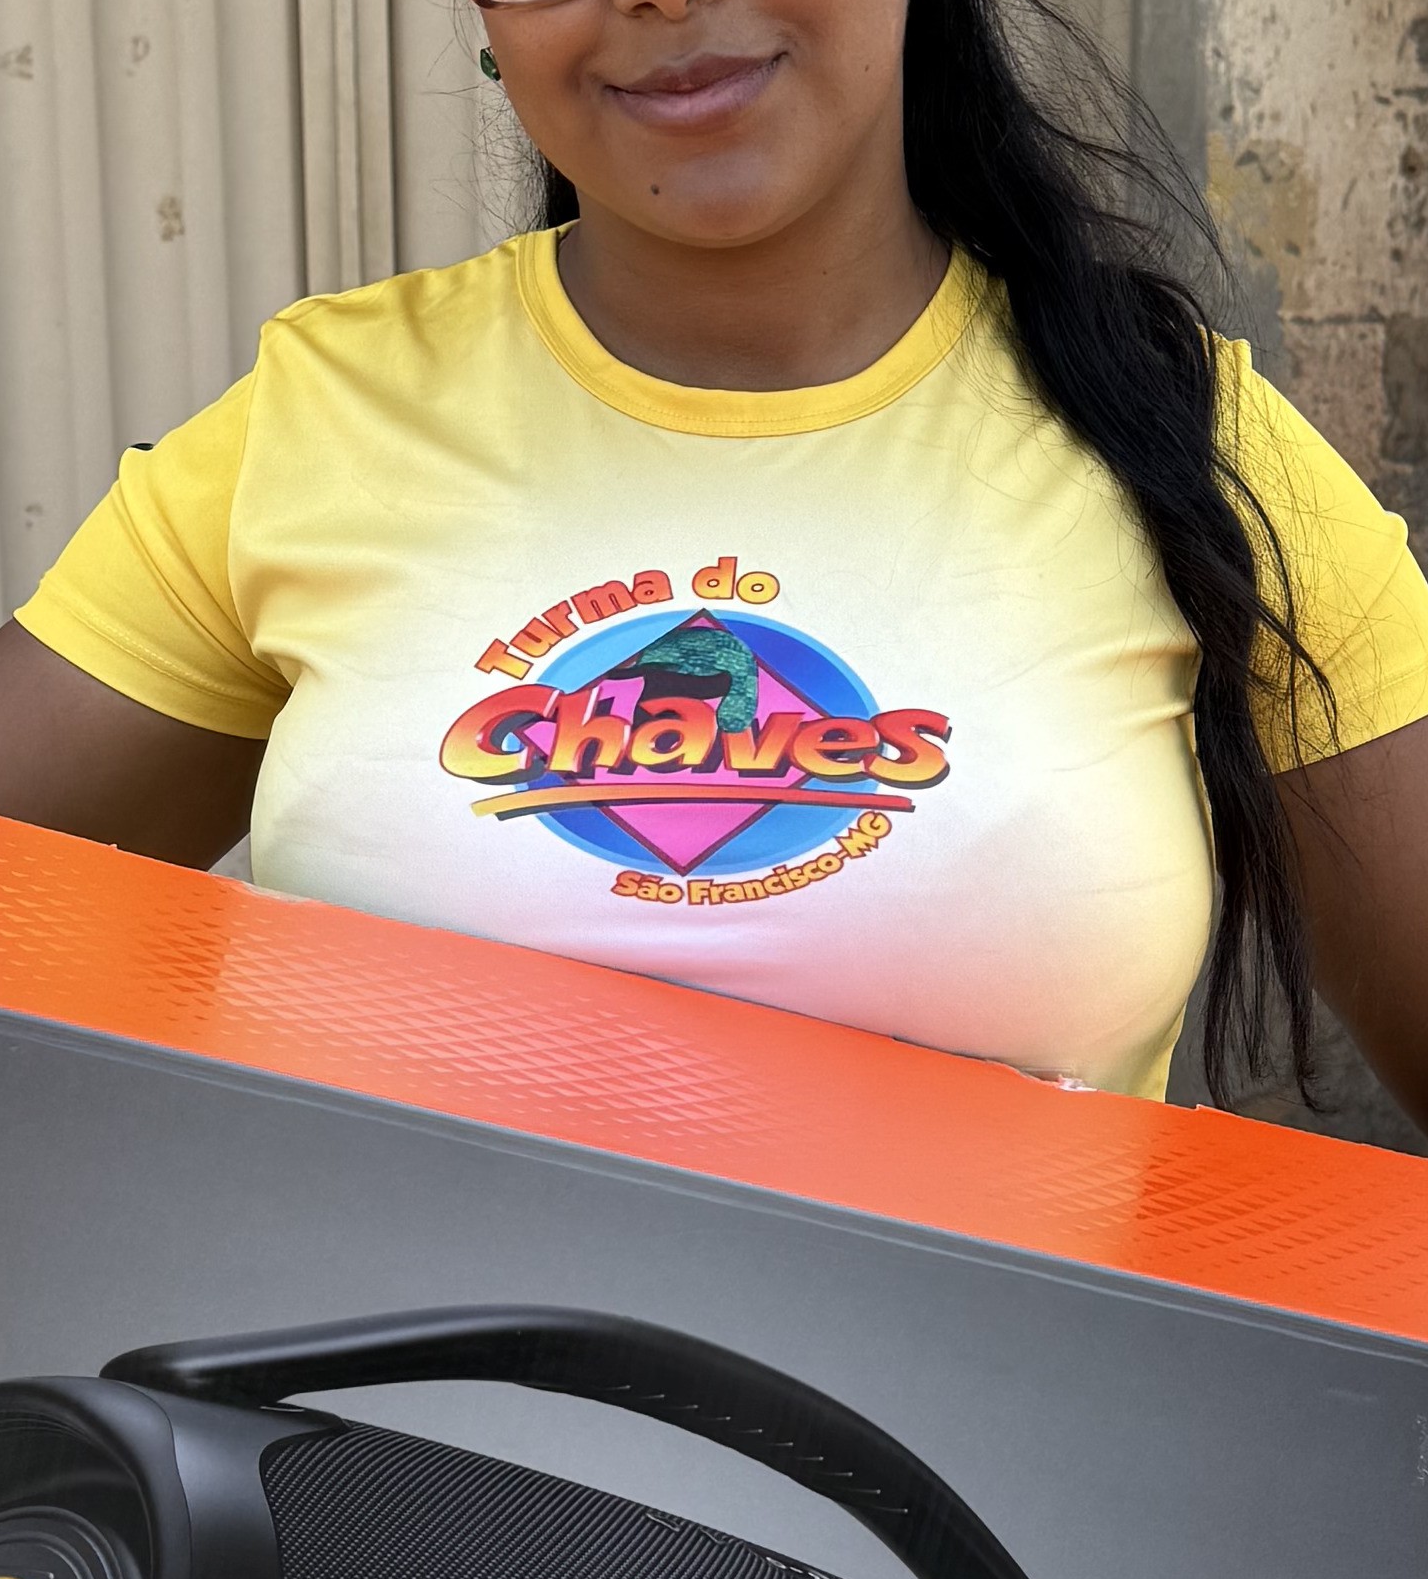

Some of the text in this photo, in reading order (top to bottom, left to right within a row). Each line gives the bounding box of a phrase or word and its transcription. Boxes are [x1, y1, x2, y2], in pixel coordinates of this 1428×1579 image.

[474, 556, 780, 679] Turma do
[439, 683, 952, 790] Chaves
[611, 811, 892, 906] São Francisco-MG
